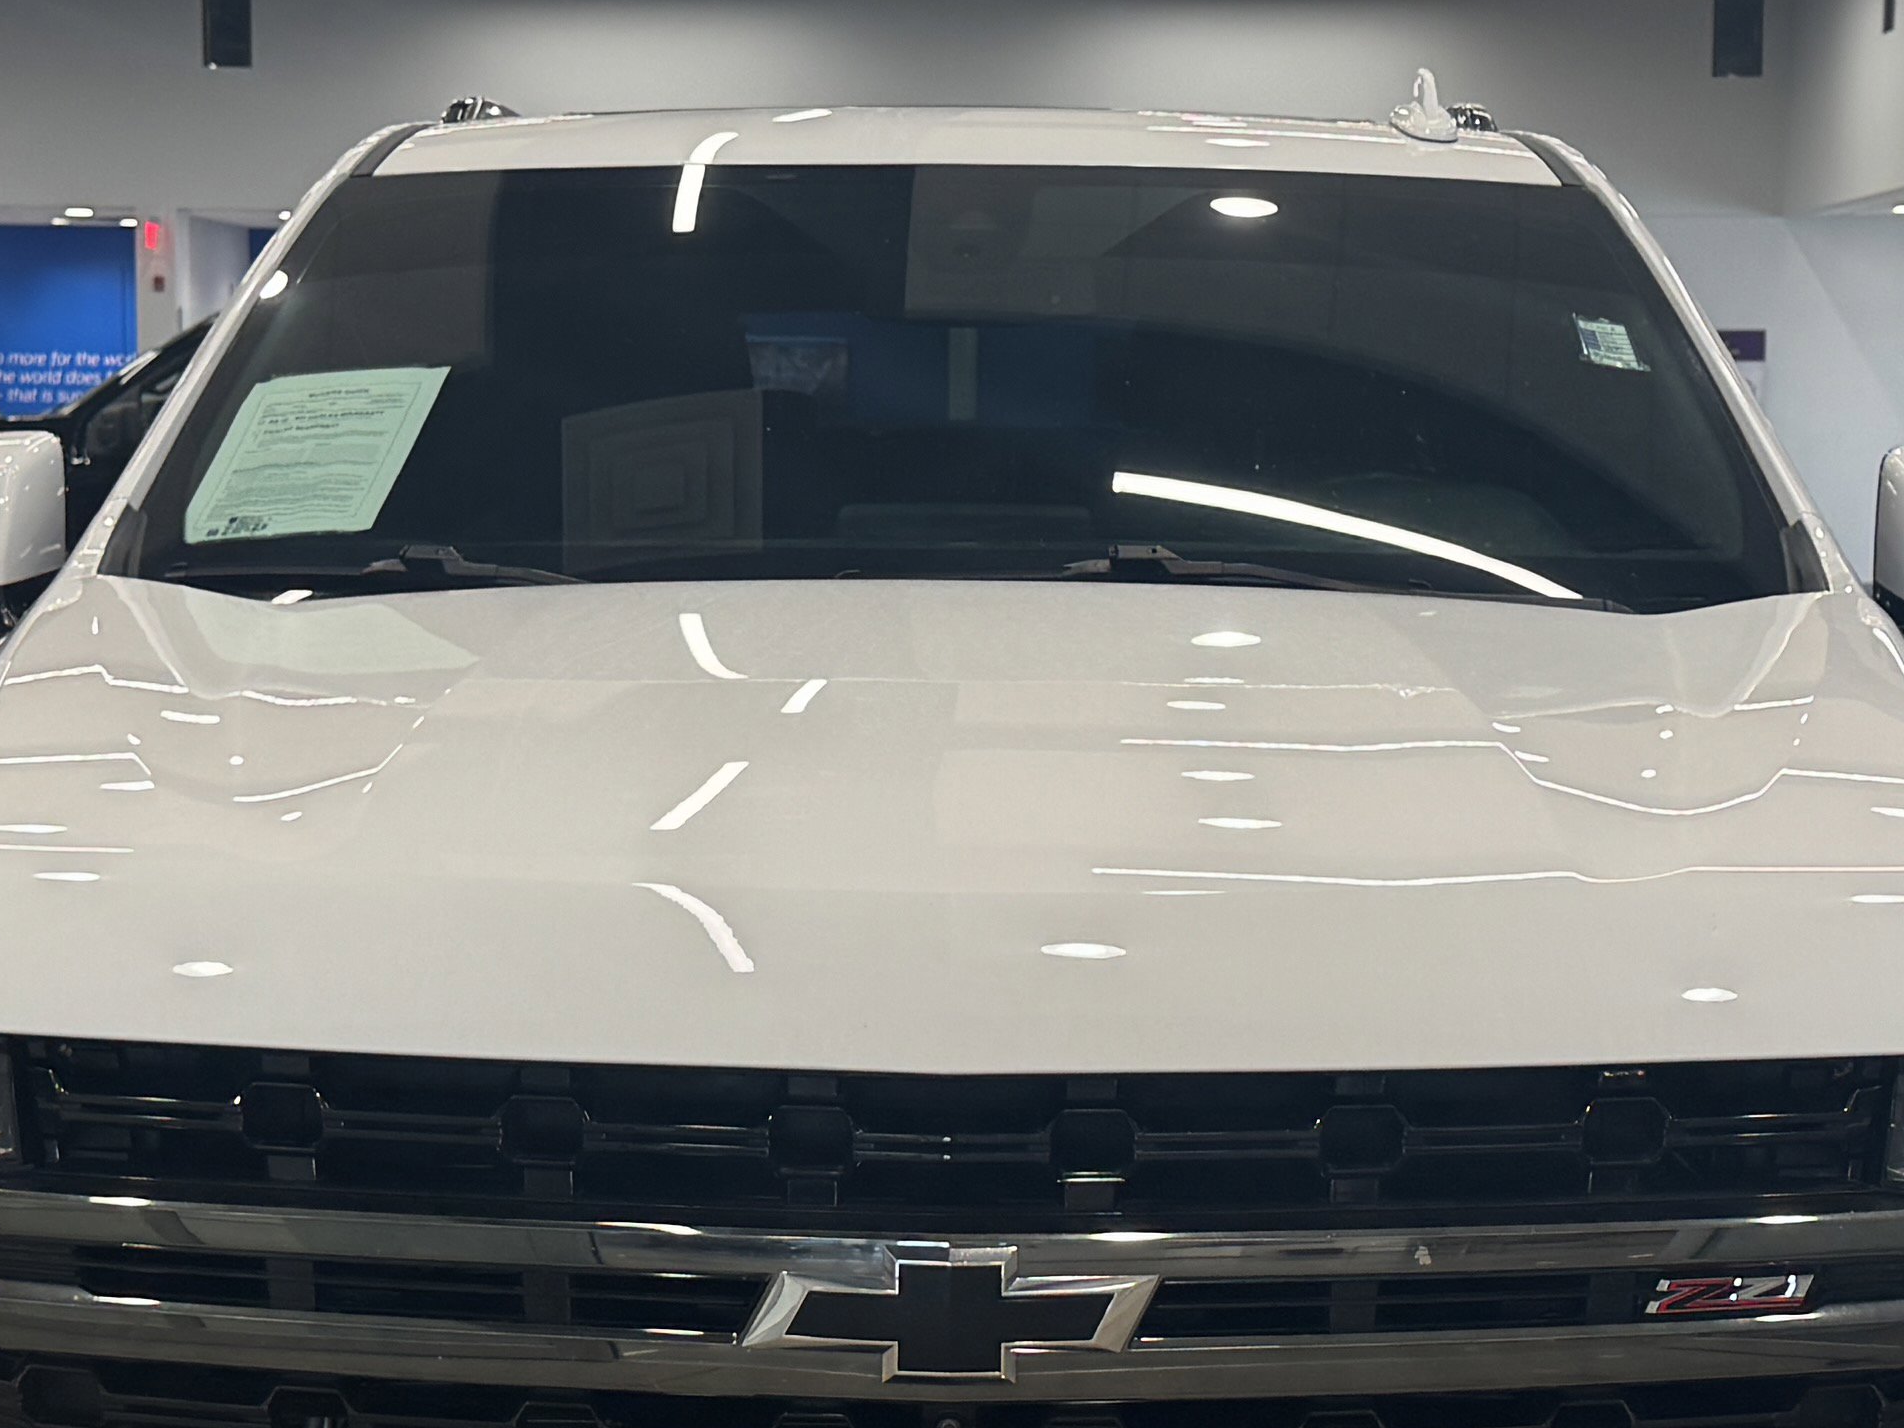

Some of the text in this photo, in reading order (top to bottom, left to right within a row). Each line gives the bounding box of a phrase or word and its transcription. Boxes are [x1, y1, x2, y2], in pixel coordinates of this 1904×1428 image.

[8, 352, 47, 366] more
[51, 351, 72, 368] for
[76, 350, 101, 366] the
[20, 370, 62, 385] world
[7, 388, 37, 403] that
[1645, 1274, 1815, 1315] Z71
